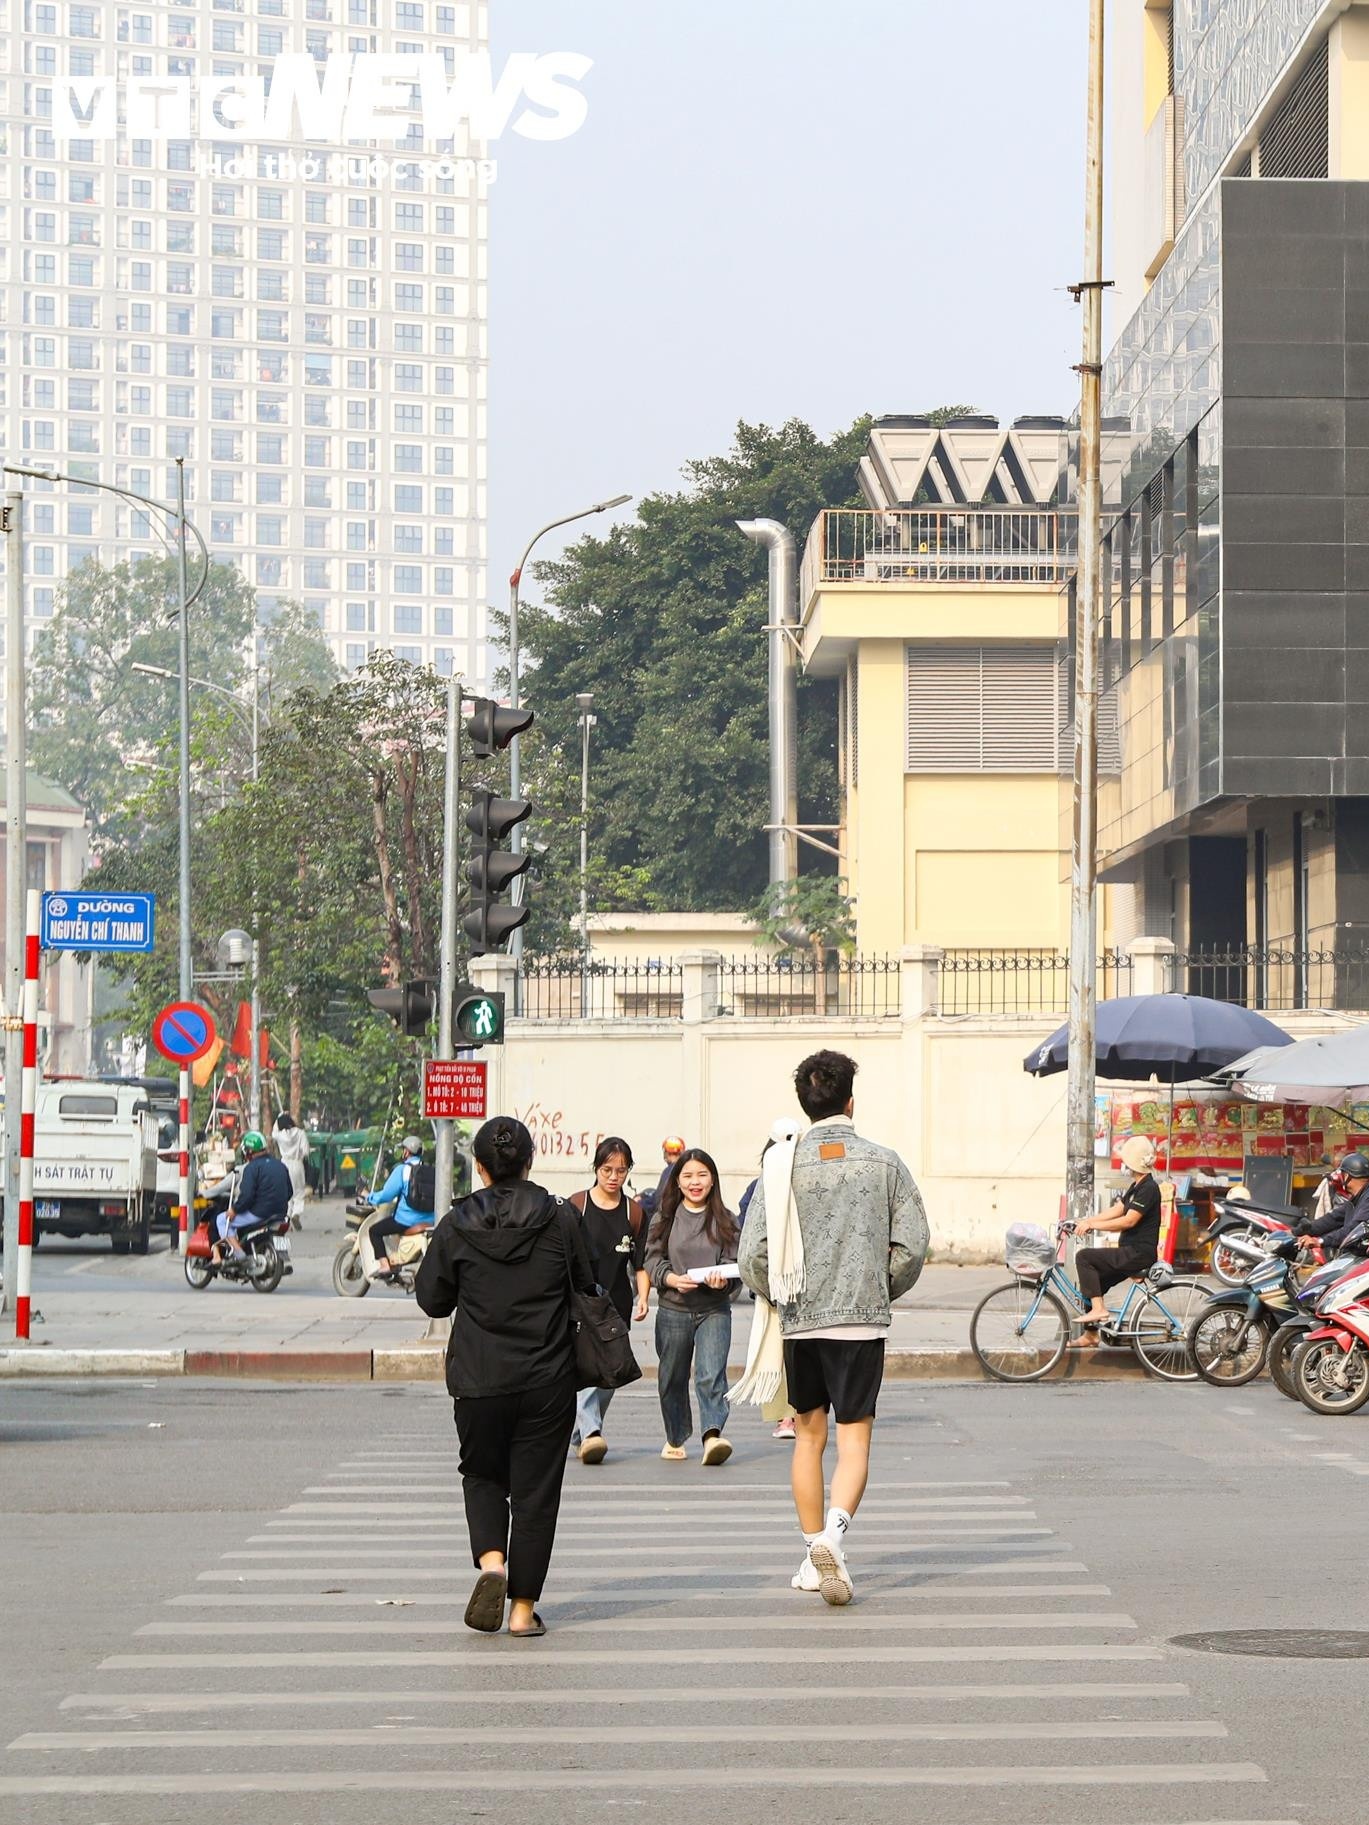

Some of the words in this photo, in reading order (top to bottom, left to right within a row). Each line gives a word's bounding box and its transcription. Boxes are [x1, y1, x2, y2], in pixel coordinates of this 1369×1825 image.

[50, 914, 89, 941] NGUYỄN
[91, 917, 111, 941] CHÍ
[112, 921, 144, 942] THANH
[45, 1164, 63, 1178] SÁT
[69, 1165, 95, 1182] TRẬT
[100, 1167, 114, 1181] TỰ
